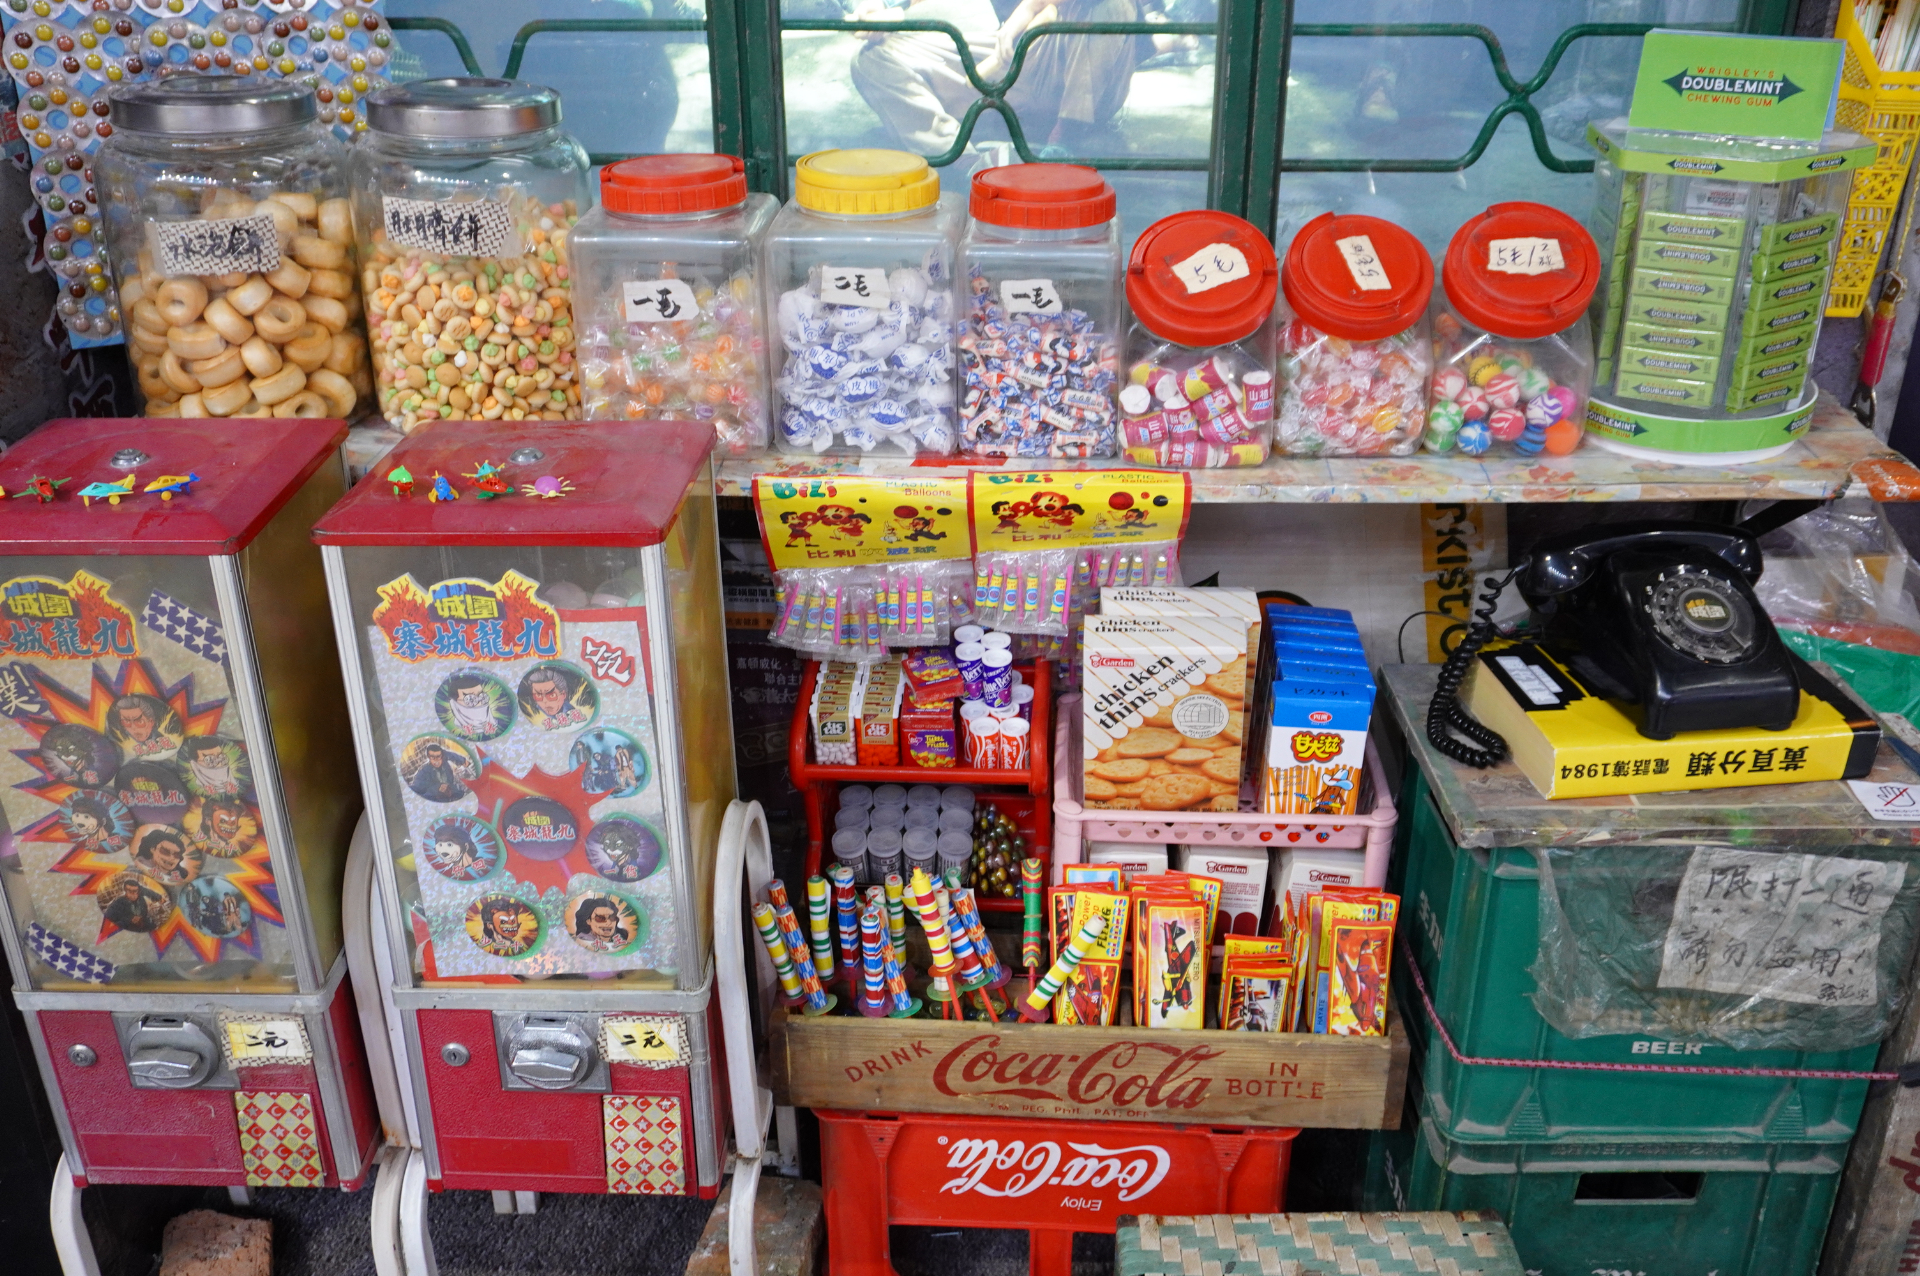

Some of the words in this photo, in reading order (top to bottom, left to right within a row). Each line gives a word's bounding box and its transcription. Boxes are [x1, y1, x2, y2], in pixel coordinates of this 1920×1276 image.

[1697, 67, 1775, 78] WRIGLEY'S
[1681, 76, 1783, 95] DOUBLEMINT
[1686, 93, 1741, 105] CHEWING
[1746, 97, 1773, 107] GUM
[1674, 161, 1717, 170] DOUBLEMINT
[1811, 158, 1841, 169] DOUBLEMINT
[1667, 225, 1716, 236] DOUBLEMINT
[1662, 250, 1711, 260] DOUBLEMINT
[834, 274, 870, 298] 二毛
[1658, 281, 1705, 292] DOUBLEMINT
[633, 288, 680, 318] 一毛
[1011, 286, 1053, 309] 一毛
[1651, 310, 1698, 321] DOUBLEMINT
[1649, 335, 1695, 345] DOUBLEMINT
[1645, 359, 1692, 370] DOUBLEMINT
[1640, 386, 1686, 396] DOUBLEMINT
[905, 489, 951, 497] Balloons
[1102, 659, 1134, 667] Garden
[1093, 655, 1175, 713] chicken
[1099, 687, 1157, 730] thins
[1157, 656, 1207, 693] crackers
[823, 727, 843, 735] tac
[826, 721, 844, 730] tic
[870, 723, 888, 731] tic
[926, 740, 949, 748] Frutti
[1294, 734, 1341, 759] 甘大滋
[1218, 865, 1247, 873] Garden
[1320, 875, 1350, 884] Garden
[1705, 864, 1874, 915] 限打一通
[1079, 893, 1091, 926] Power
[1105, 898, 1128, 957] GLIDERS
[1317, 999, 1326, 1026] HAYATE
[246, 1032, 288, 1048] 二元
[623, 1031, 665, 1049] 二元
[1631, 1040, 1702, 1055] BEER
[844, 1040, 933, 1084] DRINK
[1270, 1062, 1298, 1076] IN
[932, 1034, 1227, 1109] Coca-Cola
[940, 1139, 1171, 1202] Coca-Cola
[1061, 1195, 1102, 1211] Enjoy
